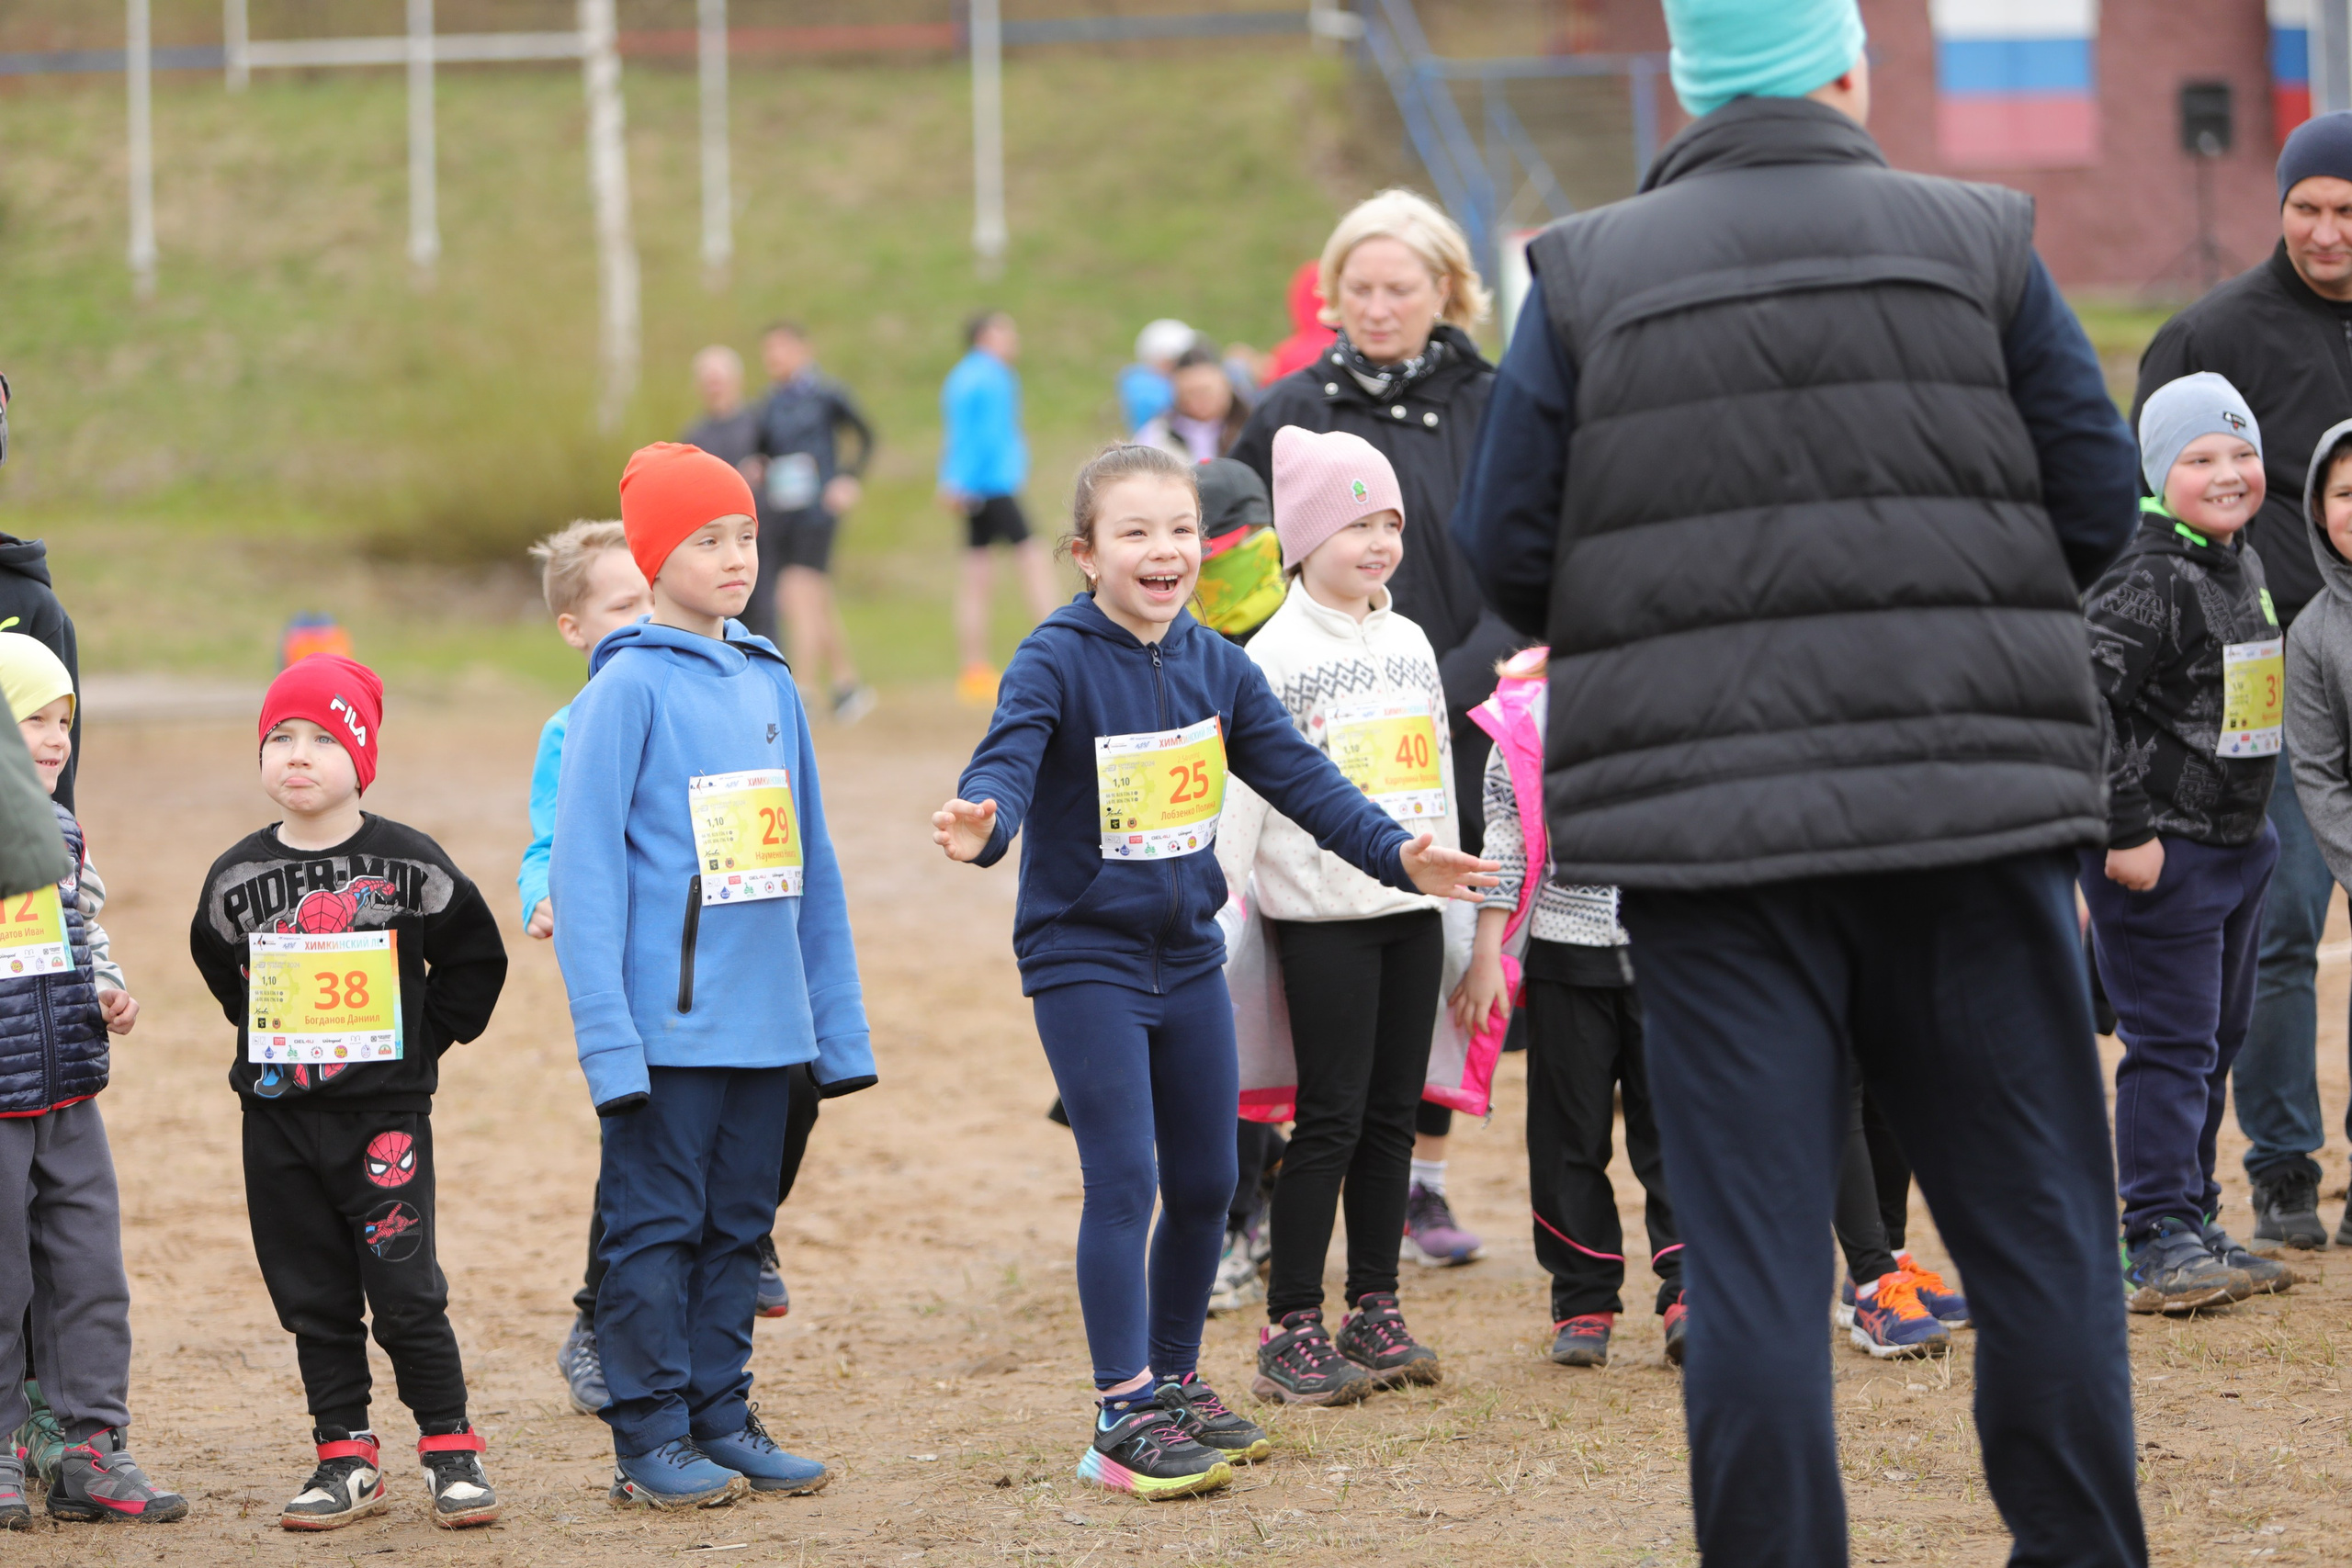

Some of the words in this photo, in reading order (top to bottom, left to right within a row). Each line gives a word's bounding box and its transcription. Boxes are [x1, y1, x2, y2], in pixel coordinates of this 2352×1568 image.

[330, 693, 367, 747] FILA
[1395, 733, 1430, 769] 40
[1113, 777, 1130, 788] 1,10
[1169, 760, 1209, 805] 25
[1160, 808, 1195, 821] Лобзенко
[1195, 800, 1216, 813] Полина
[707, 817, 725, 829] 1,10
[759, 807, 789, 845] 29
[24, 927, 45, 937] Иван
[304, 936, 369, 951] ХИМКИНСКИЙ
[371, 936, 387, 947] ЛЕС
[262, 976, 277, 987] 1,10
[314, 970, 370, 1010] 38
[304, 1015, 345, 1026] Богданов
[347, 1014, 380, 1025] Даниил
